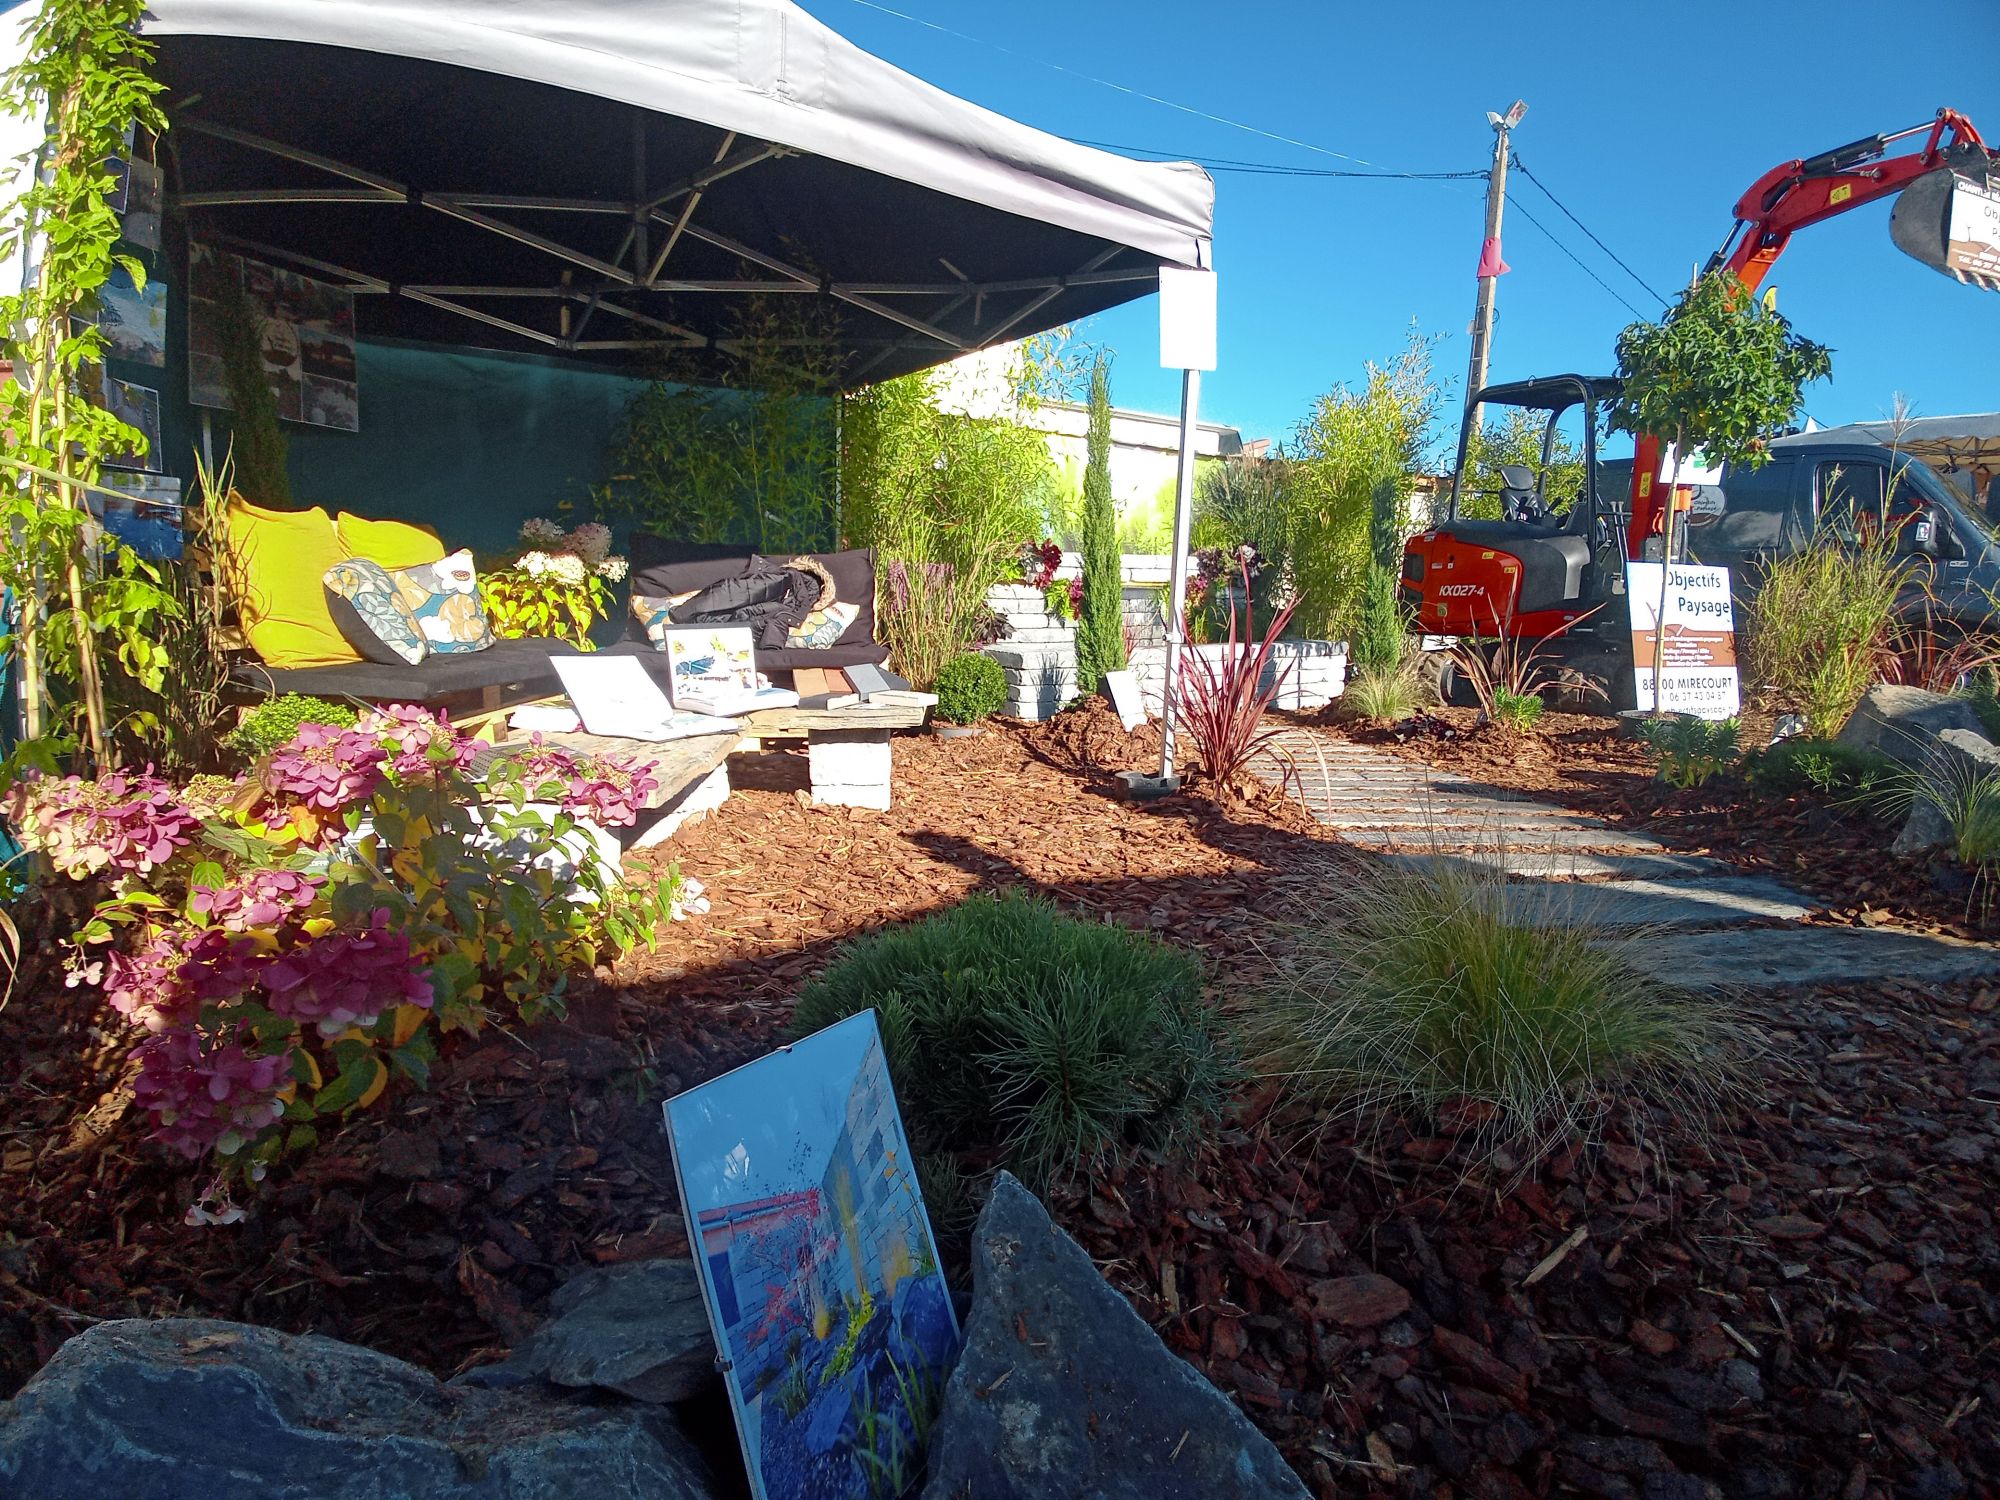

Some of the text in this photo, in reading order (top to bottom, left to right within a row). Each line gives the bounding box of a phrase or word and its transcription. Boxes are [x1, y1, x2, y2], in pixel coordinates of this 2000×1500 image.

[1438, 584, 1485, 597] KX027-4
[1678, 596, 1730, 617] Paysage
[1642, 677, 1732, 691] 8800 MIRECOURT
